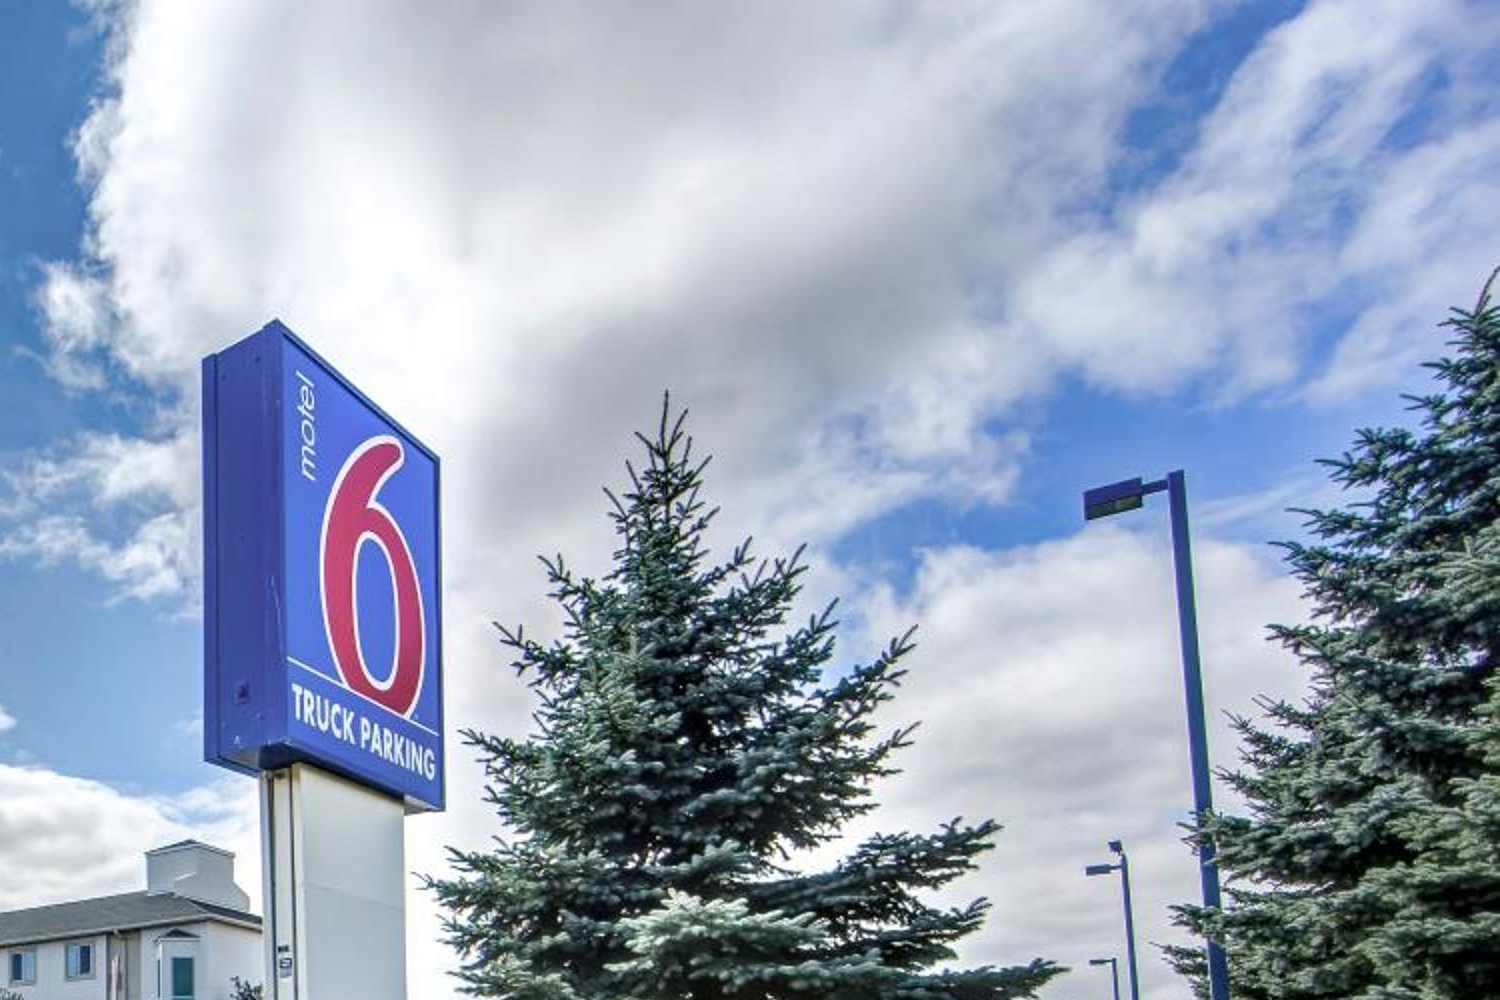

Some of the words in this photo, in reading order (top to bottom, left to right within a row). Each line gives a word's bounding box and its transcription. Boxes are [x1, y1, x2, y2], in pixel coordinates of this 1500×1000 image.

[296, 370, 316, 481] motel
[320, 435, 425, 718] 6
[291, 683, 356, 745] TRUCK
[360, 717, 436, 781] PARKING
